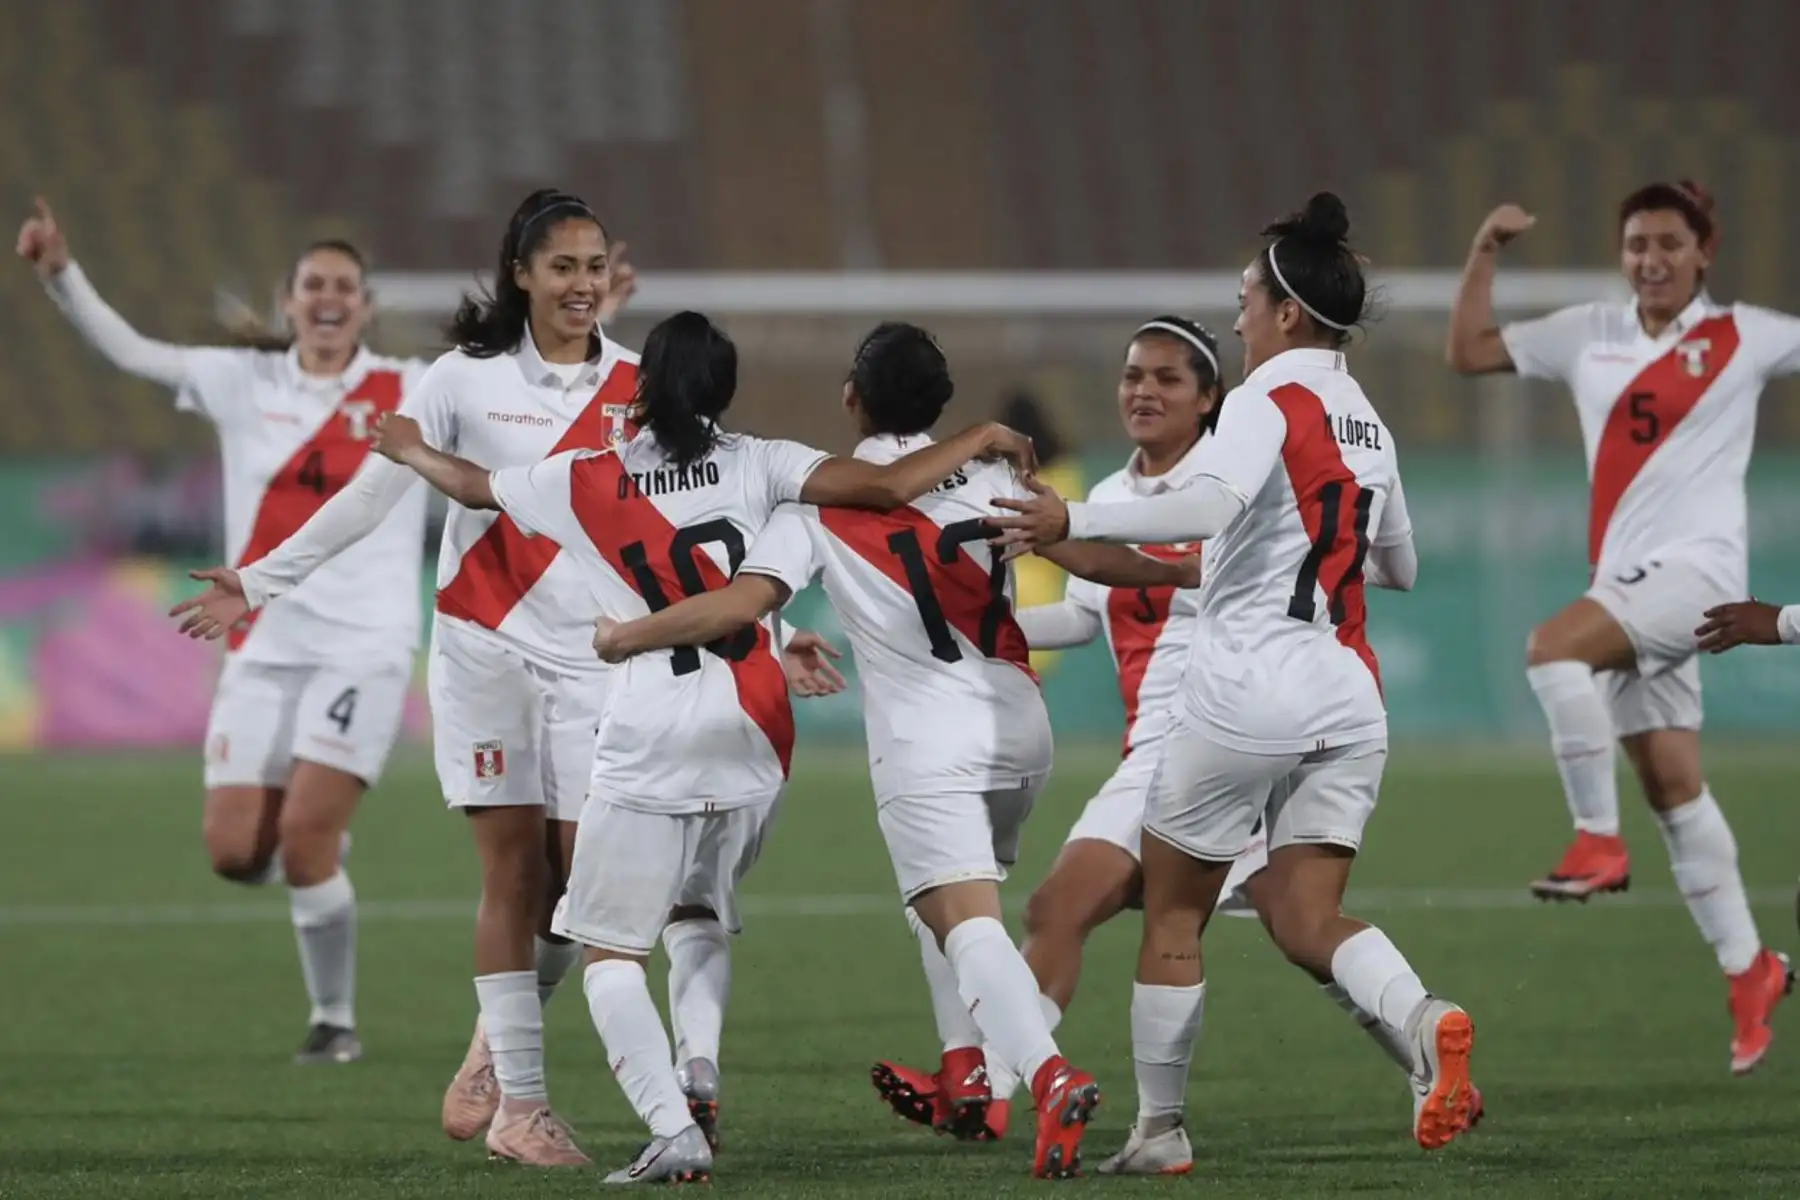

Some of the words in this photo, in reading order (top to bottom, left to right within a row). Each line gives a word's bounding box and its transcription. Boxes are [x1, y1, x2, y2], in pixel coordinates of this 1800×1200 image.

[487, 410, 553, 427] marathon
[1338, 413, 1382, 451] LÓPEZ
[1629, 392, 1659, 445] 5
[297, 450, 326, 497] 4
[617, 460, 720, 501] OTINIANO
[1287, 480, 1375, 625] 11
[326, 686, 358, 735] 4
